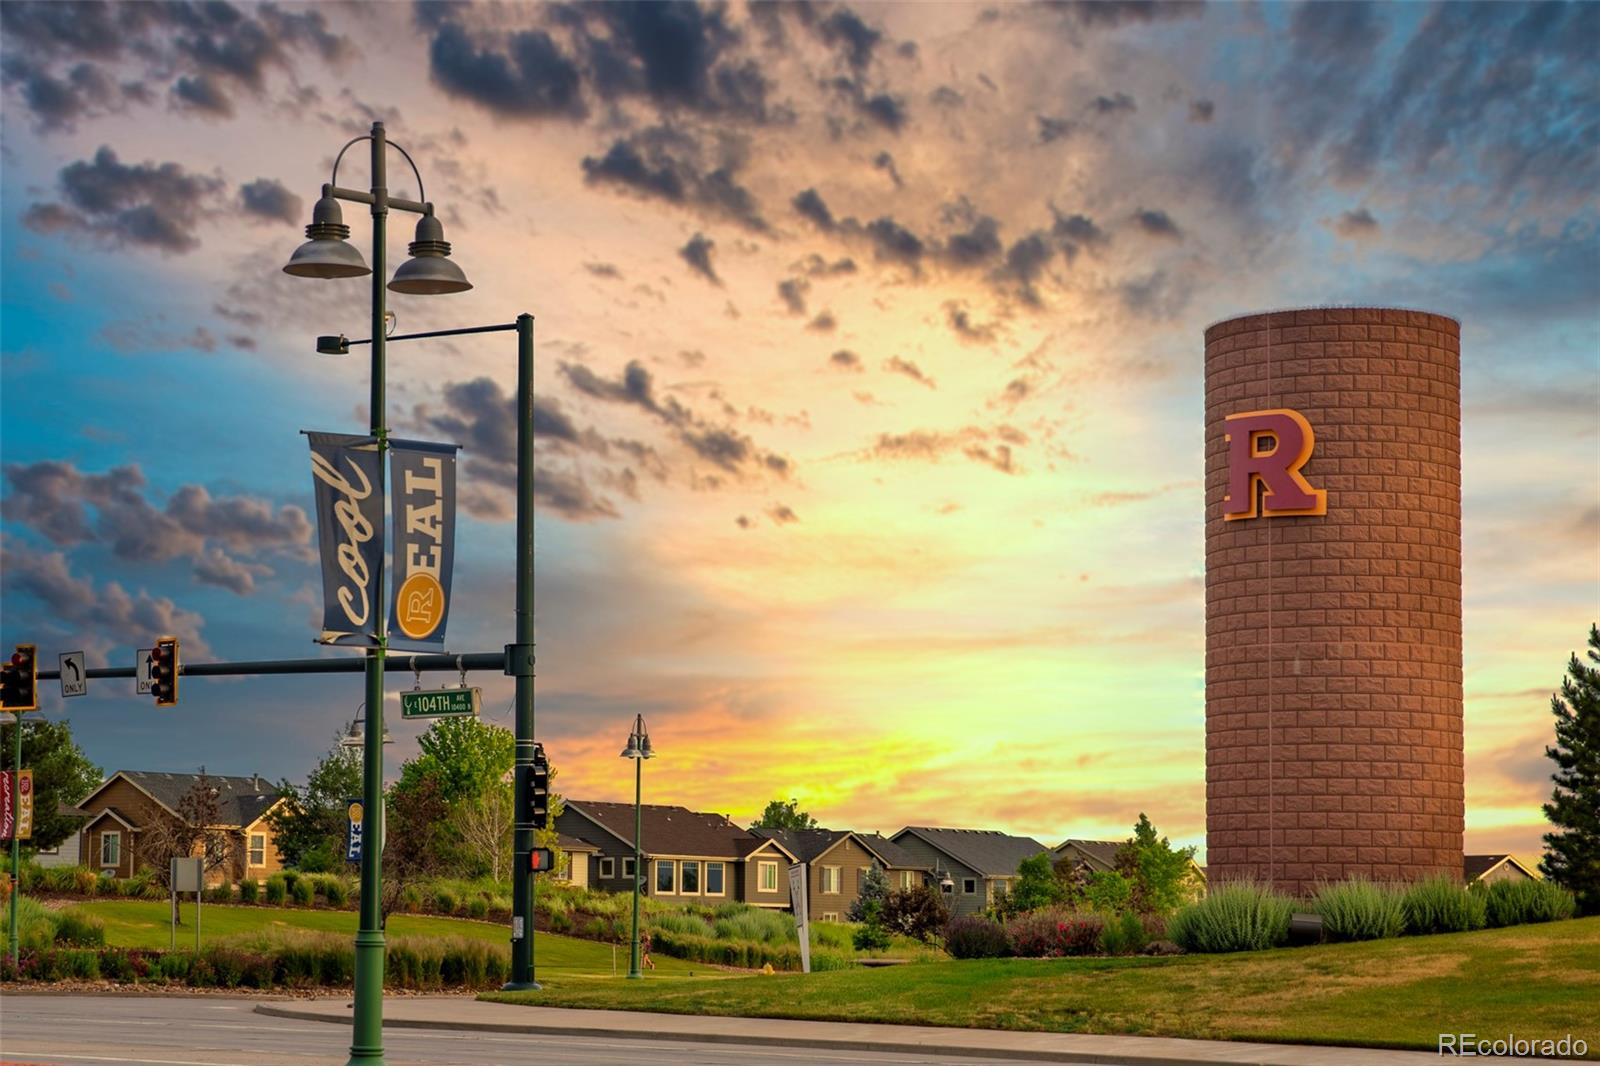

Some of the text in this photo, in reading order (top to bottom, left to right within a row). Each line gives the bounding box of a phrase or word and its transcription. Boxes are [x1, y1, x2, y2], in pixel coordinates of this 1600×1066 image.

[1223, 408, 1328, 522] R
[404, 457, 443, 625] REAL
[64, 682, 83, 694] ONLY
[140, 681, 154, 691] ON
[418, 695, 450, 712] 104TH
[456, 694, 465, 702] AVE
